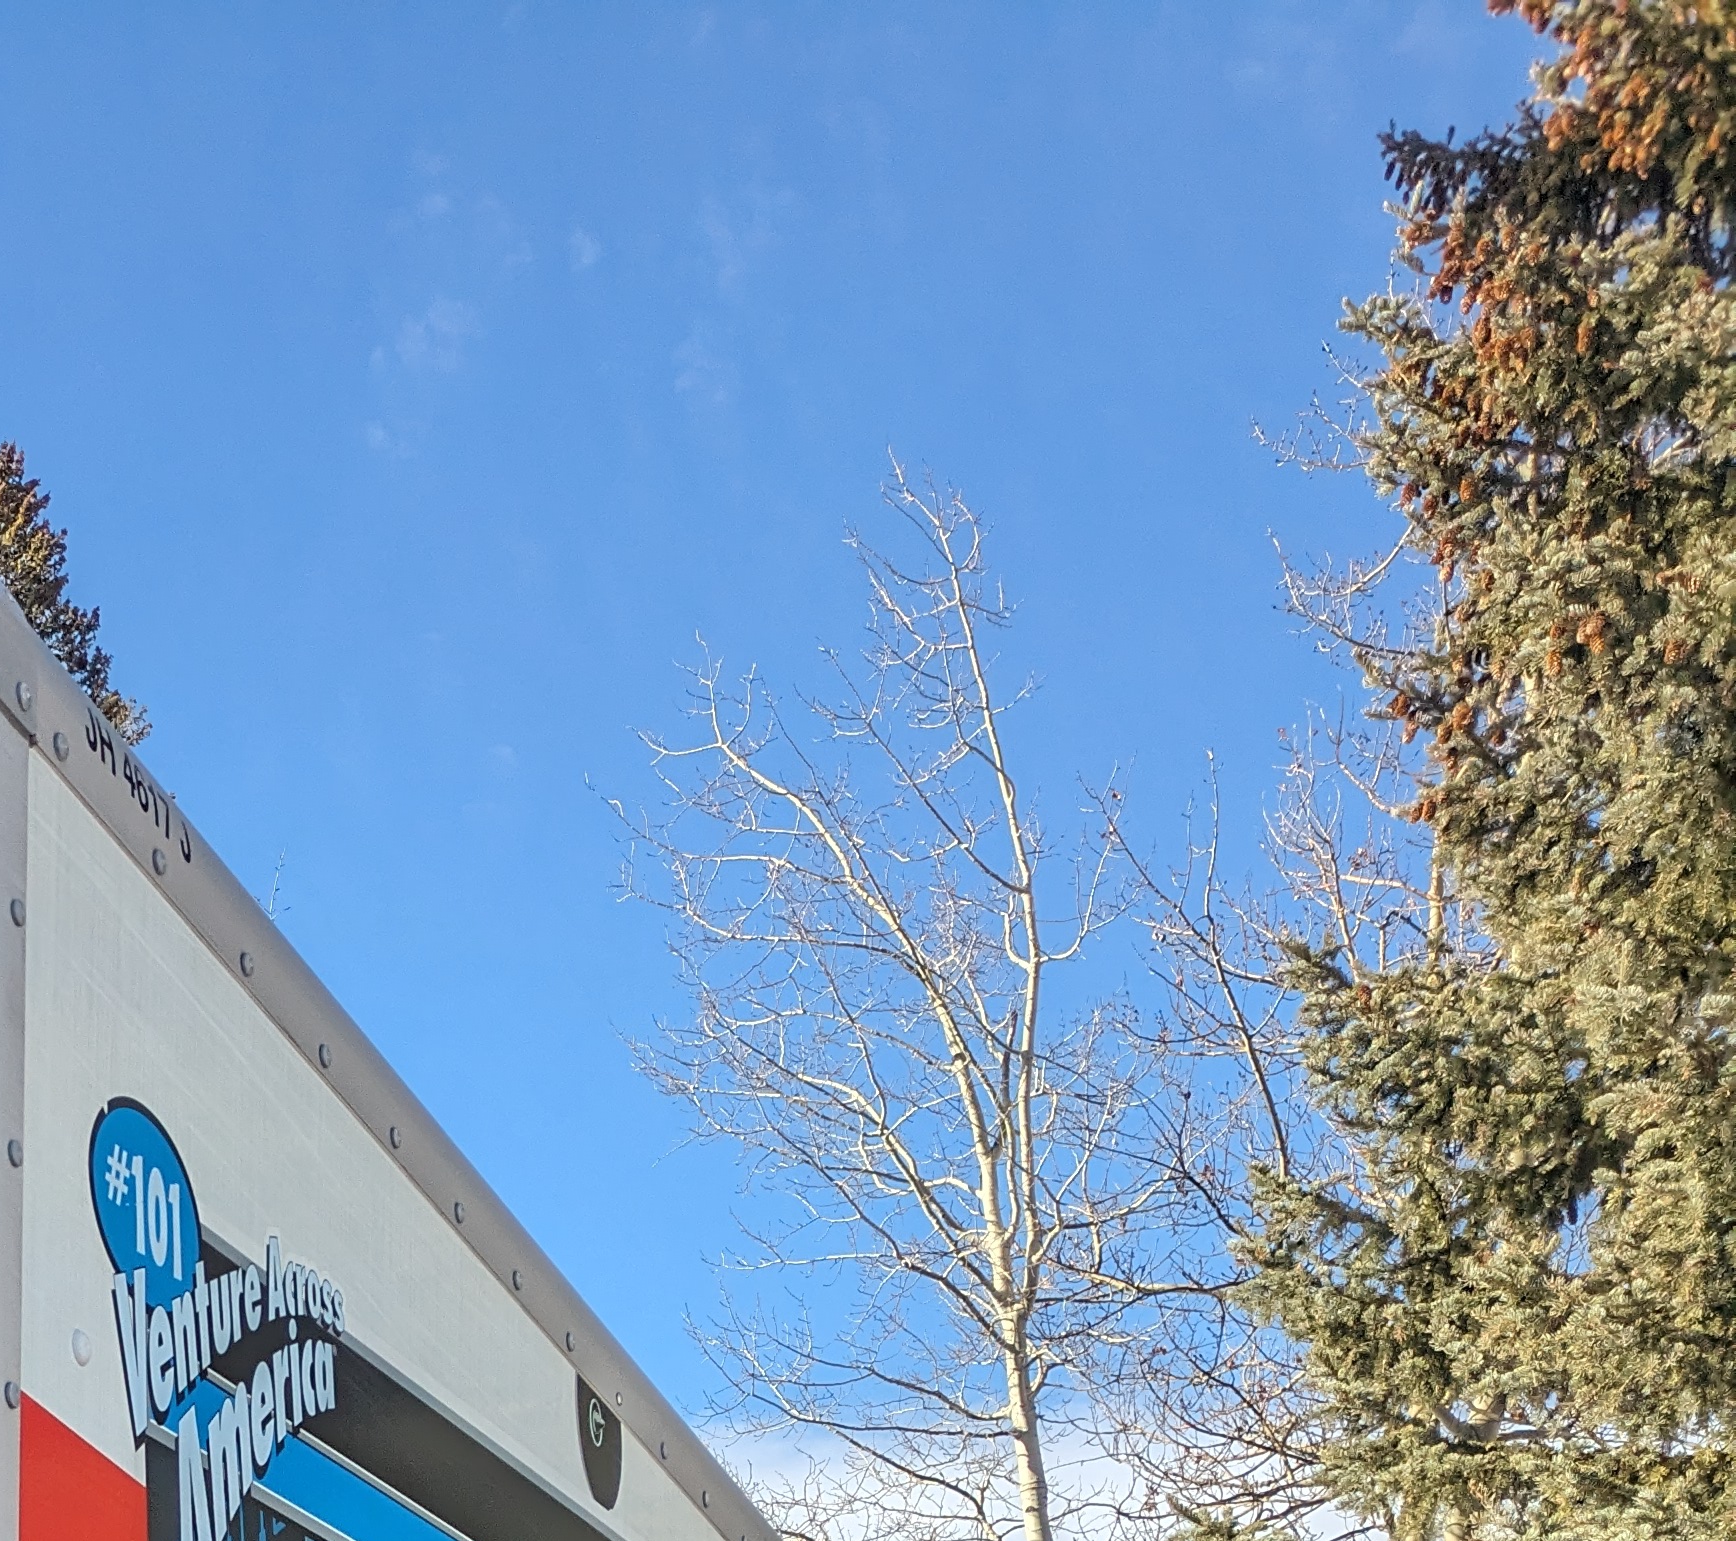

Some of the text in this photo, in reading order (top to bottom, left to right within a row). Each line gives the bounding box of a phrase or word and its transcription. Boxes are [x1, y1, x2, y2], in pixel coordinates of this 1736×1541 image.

[85, 708, 193, 864] JH 4617 J
[105, 1144, 182, 1280] #101
[114, 1235, 345, 1438] Venture Across
